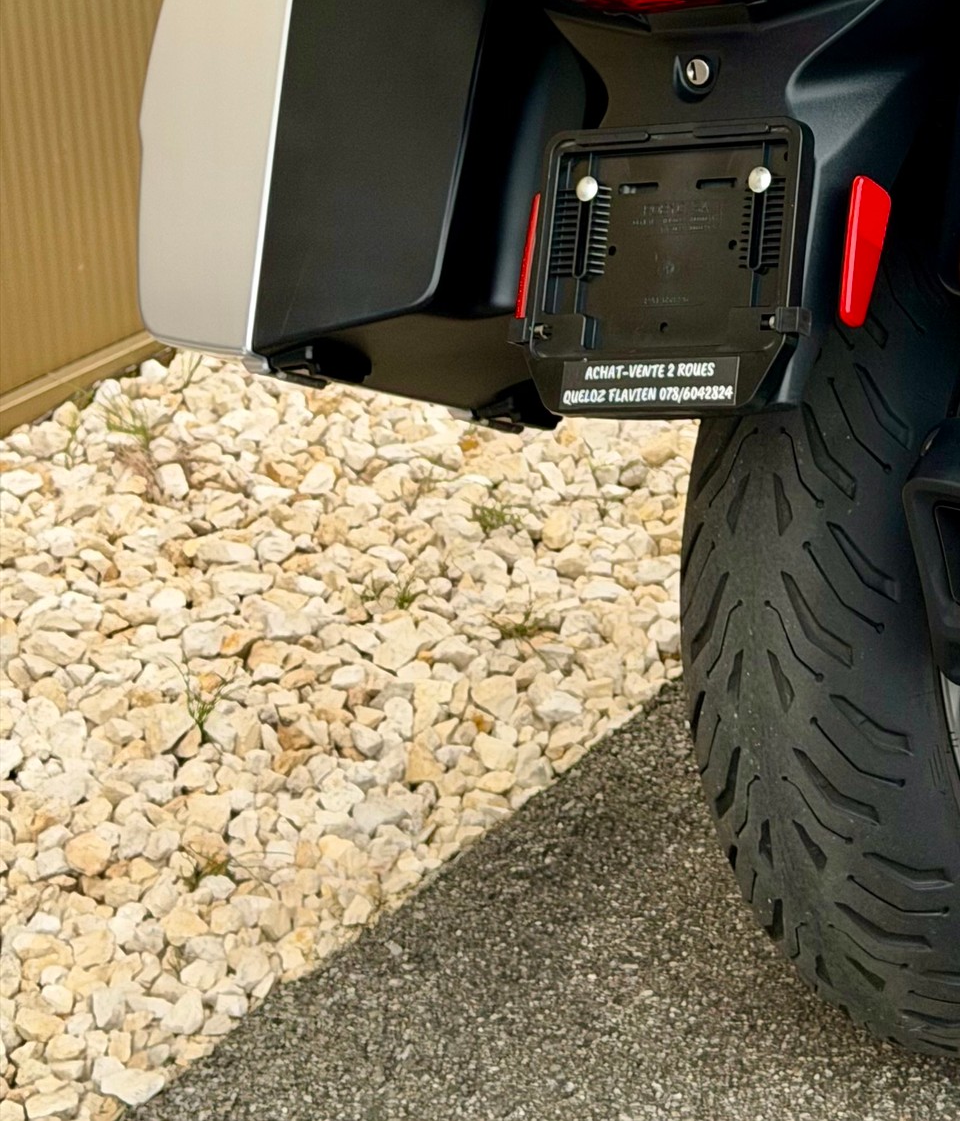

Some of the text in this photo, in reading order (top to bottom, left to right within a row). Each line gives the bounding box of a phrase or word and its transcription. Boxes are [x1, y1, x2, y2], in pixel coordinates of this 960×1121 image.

[584, 362, 716, 380] ACHAT-VENTE 2 ROUES
[562, 385, 734, 405] QUELOZ FLAVIEN 078/6042824
